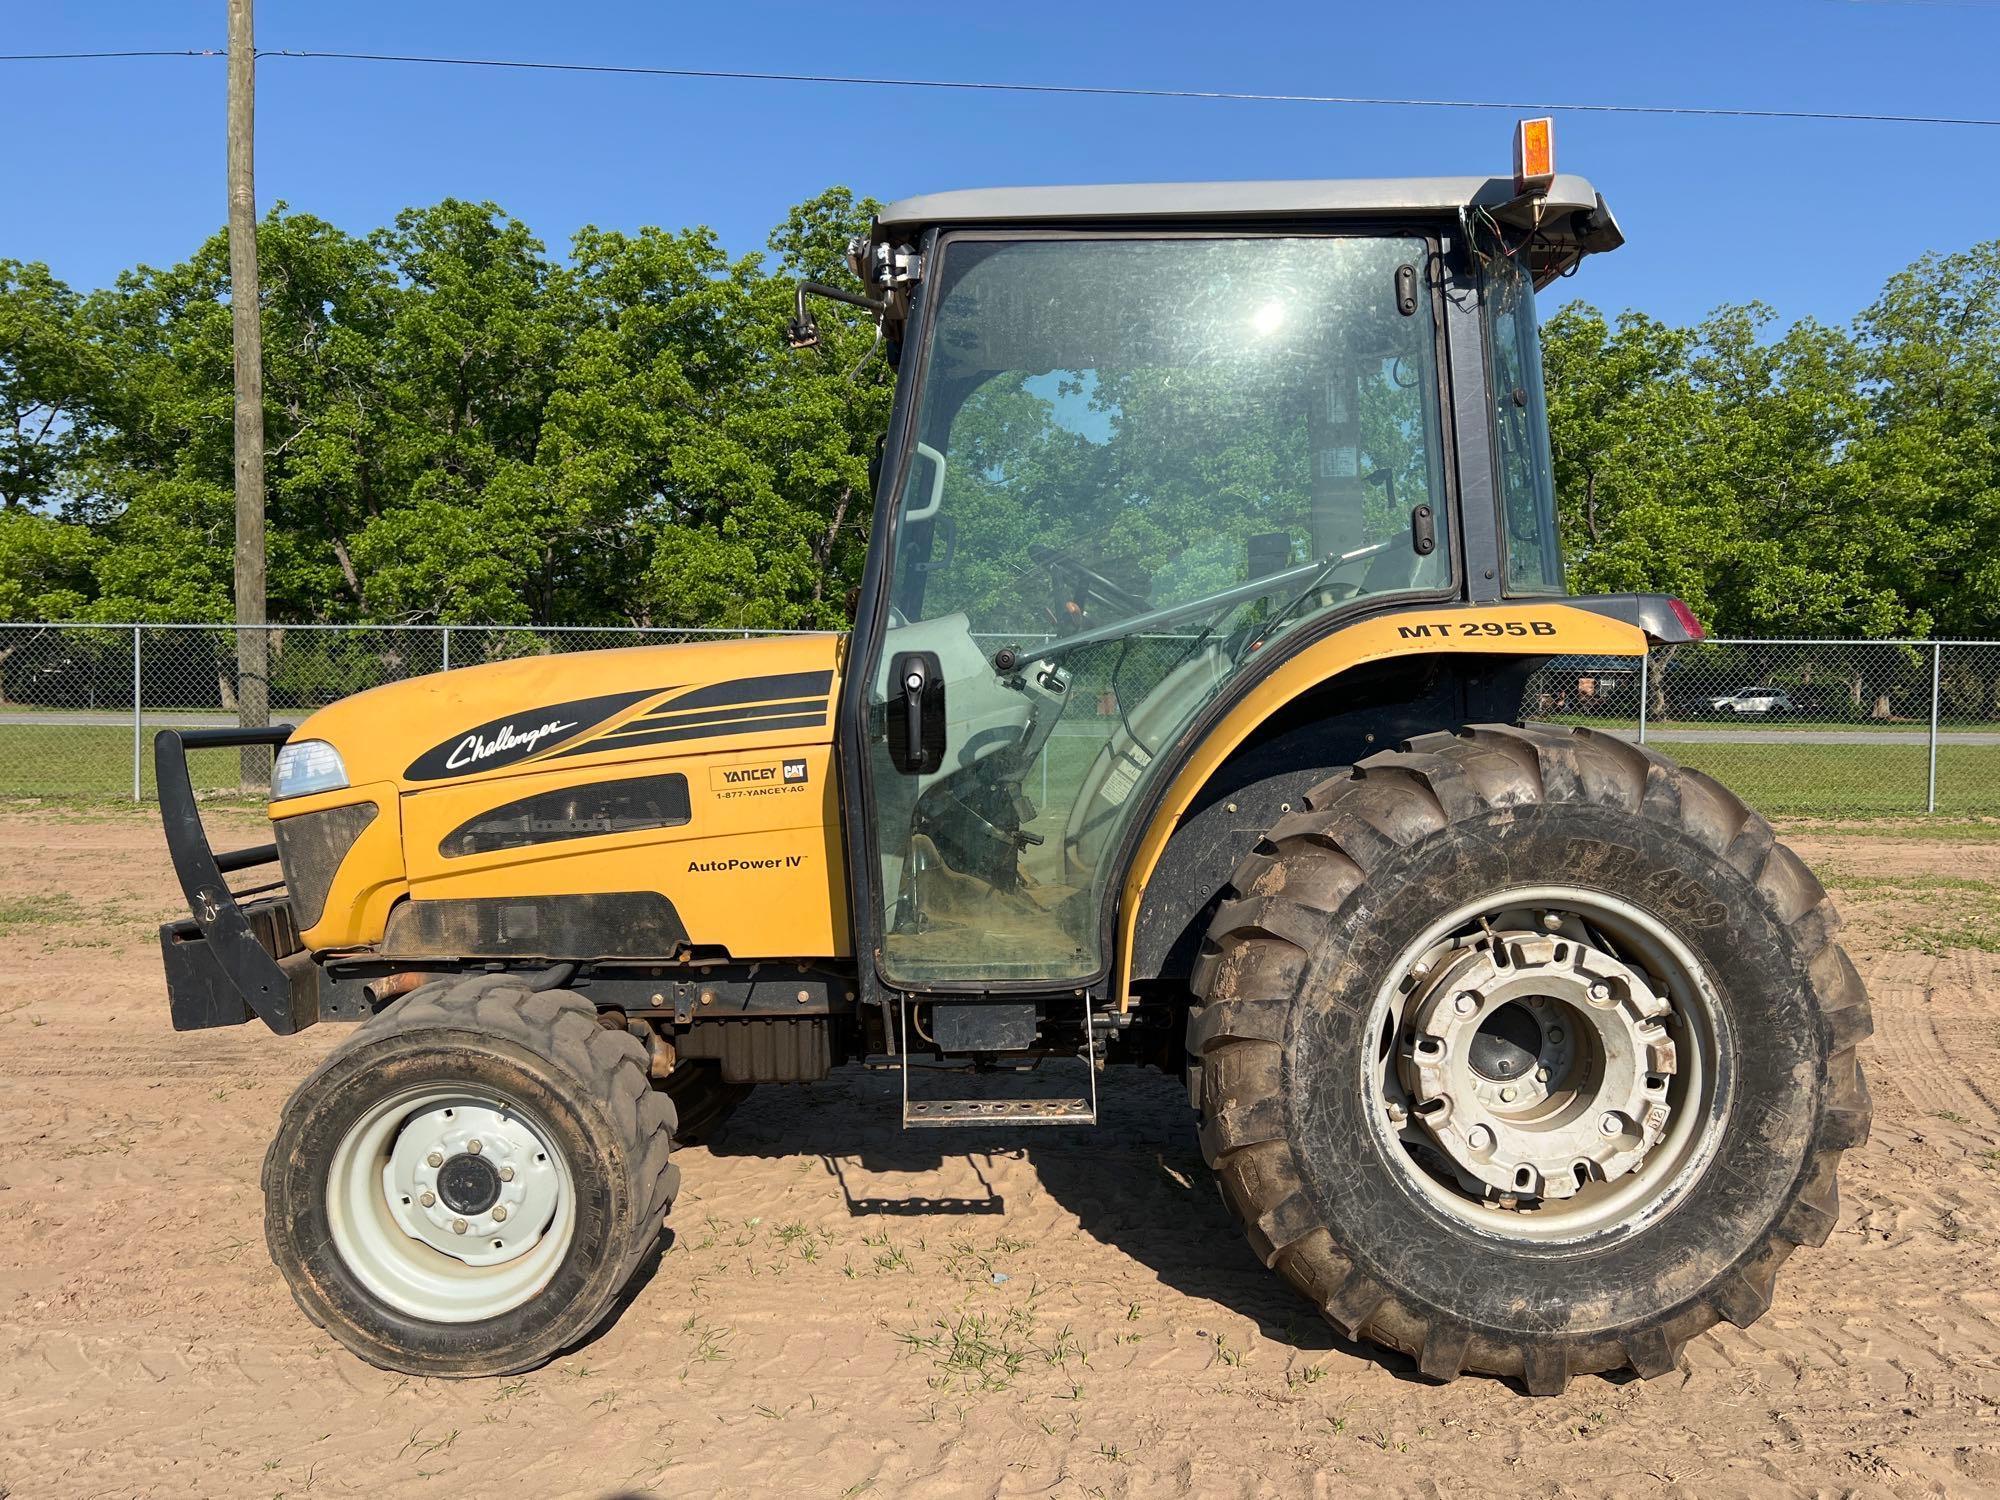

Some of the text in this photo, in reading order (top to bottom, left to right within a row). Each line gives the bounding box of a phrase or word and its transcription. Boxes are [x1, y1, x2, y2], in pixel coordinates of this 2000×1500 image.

[1397, 622, 1557, 638] MT 295B
[445, 721, 578, 769] Challenger
[723, 764, 805, 783] YANCEY CAT
[716, 785, 805, 799] 1-877-YANCEY-AG
[687, 859, 782, 873] AutoPower
[1644, 867, 1730, 929] 459
